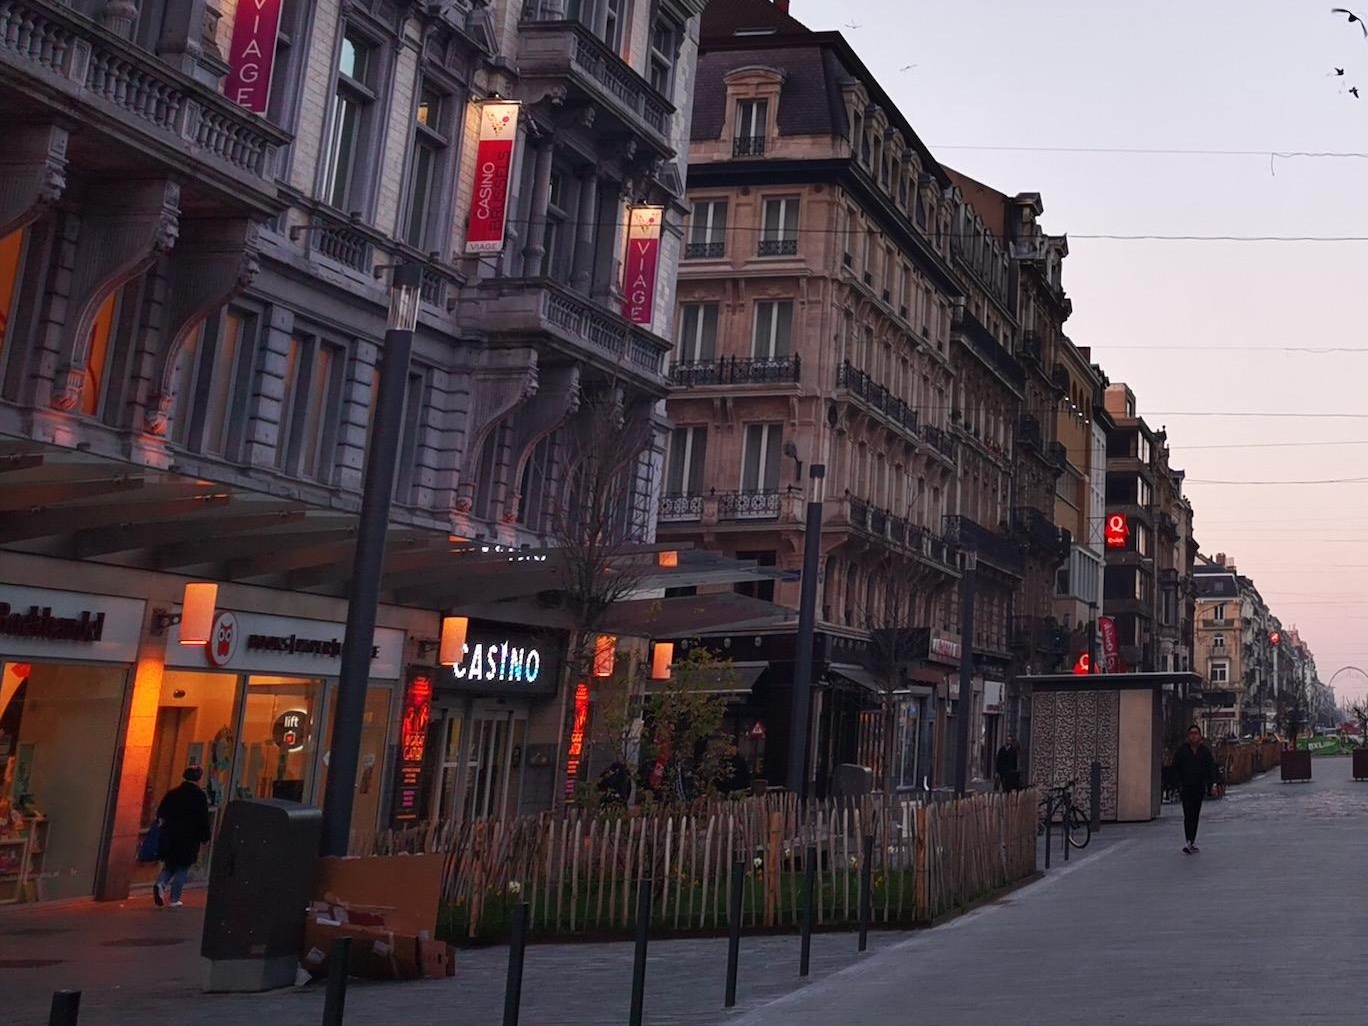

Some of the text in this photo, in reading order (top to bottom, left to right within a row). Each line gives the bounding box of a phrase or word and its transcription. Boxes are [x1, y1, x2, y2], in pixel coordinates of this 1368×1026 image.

[477, 162, 495, 220] CASINO
[470, 242, 498, 252] VIAGE
[631, 241, 650, 321] VIAGE
[1109, 515, 1124, 533] Q
[453, 639, 540, 683] CASINO
[284, 715, 300, 728] lift
